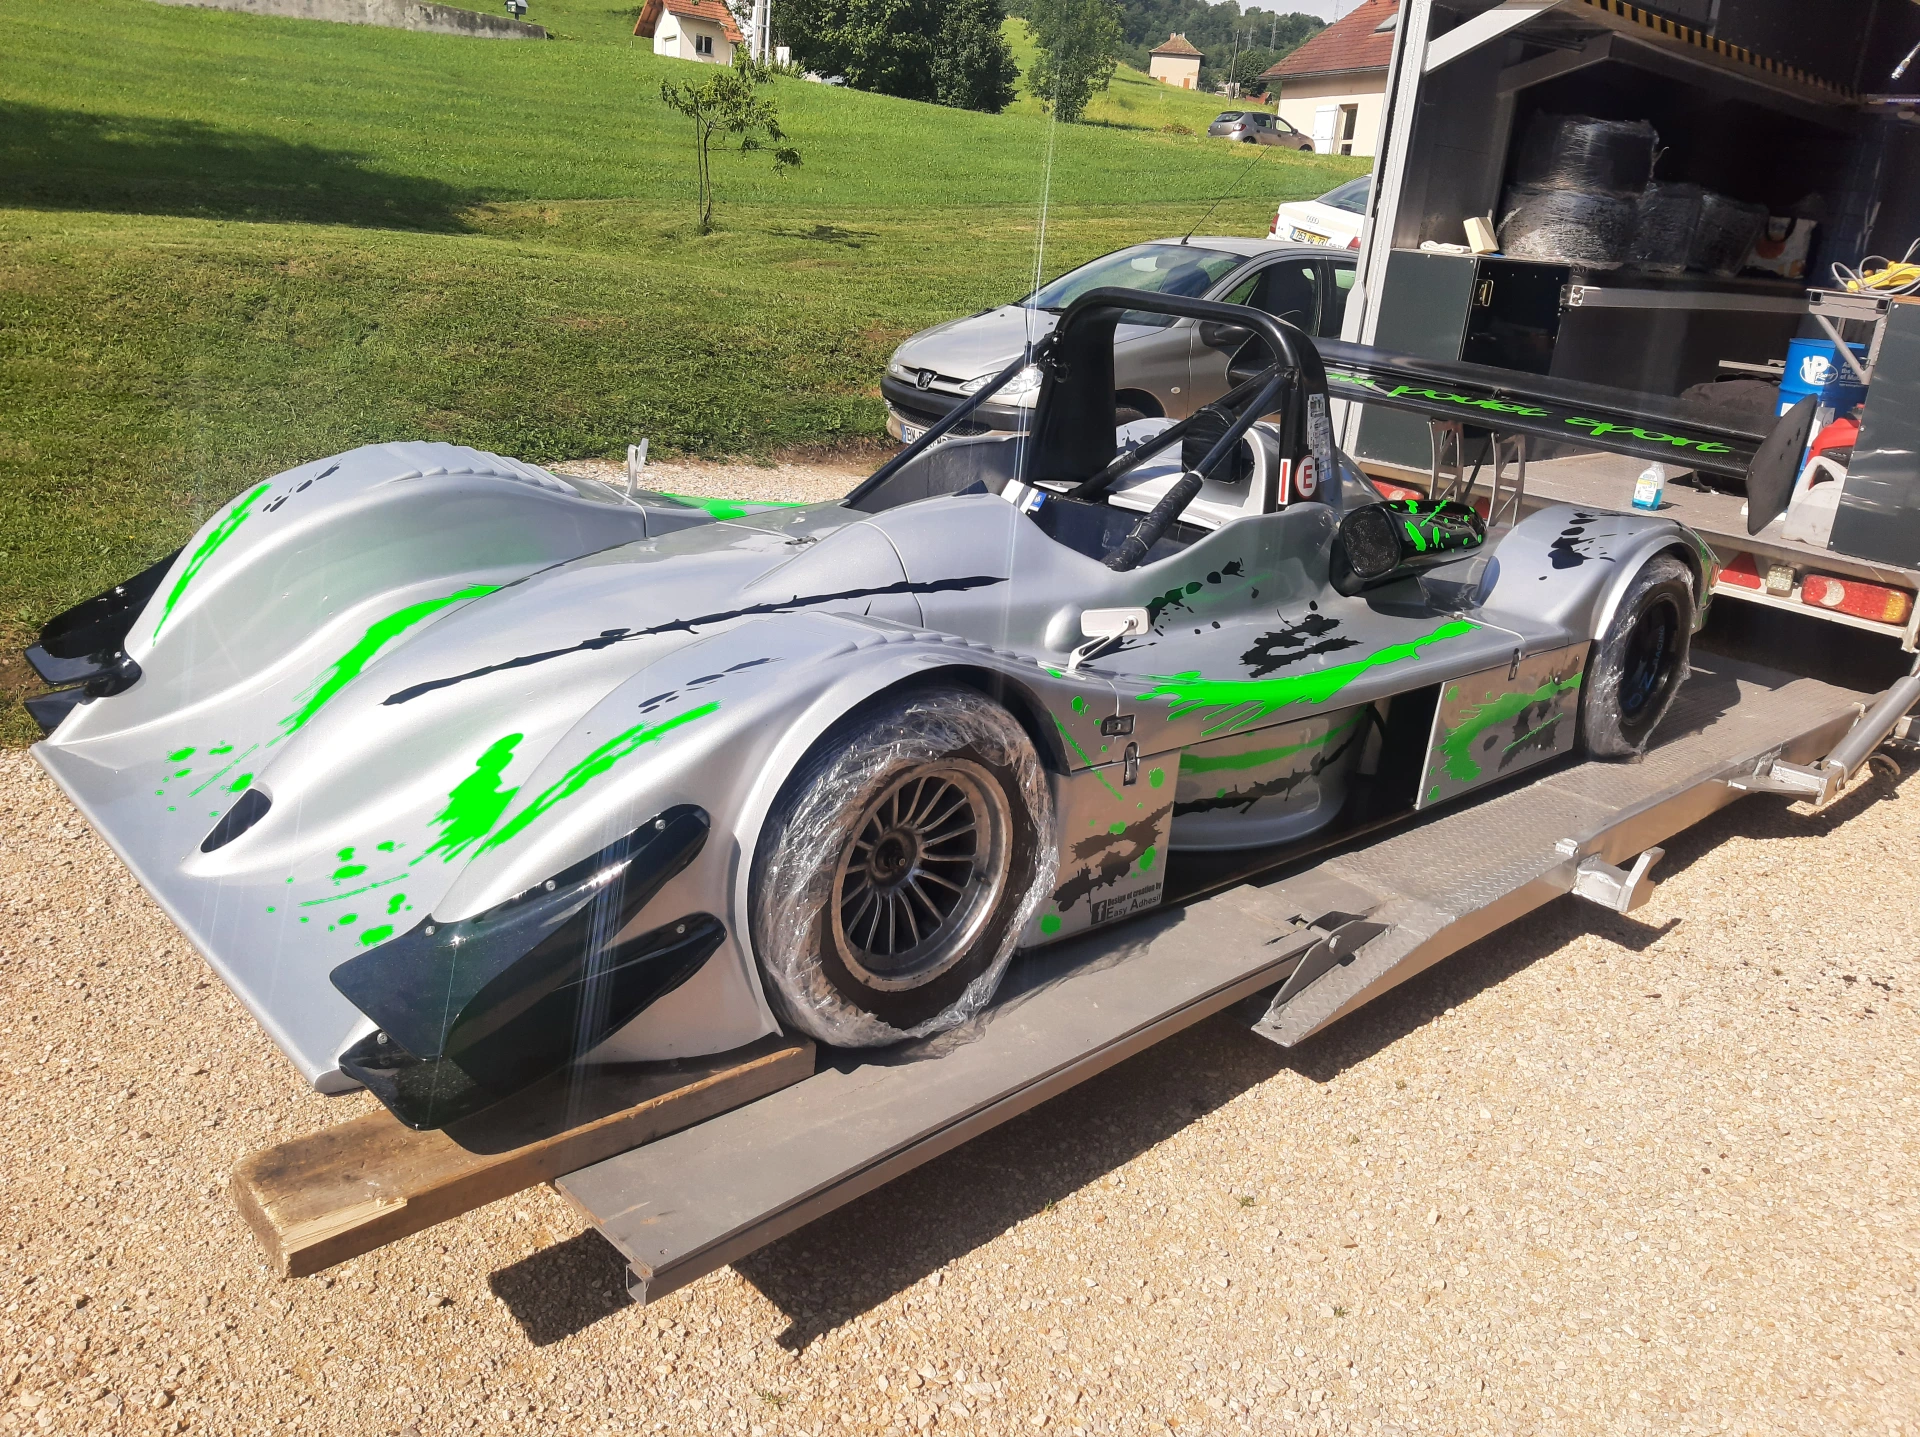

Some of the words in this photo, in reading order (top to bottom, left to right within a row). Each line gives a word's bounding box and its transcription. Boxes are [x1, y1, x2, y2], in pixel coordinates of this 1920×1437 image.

[1387, 385, 1553, 417] poulet
[1564, 416, 1735, 453] sport
[1303, 465, 1312, 489] E
[1133, 884, 1155, 898] creation
[1107, 906, 1127, 919] Easy
